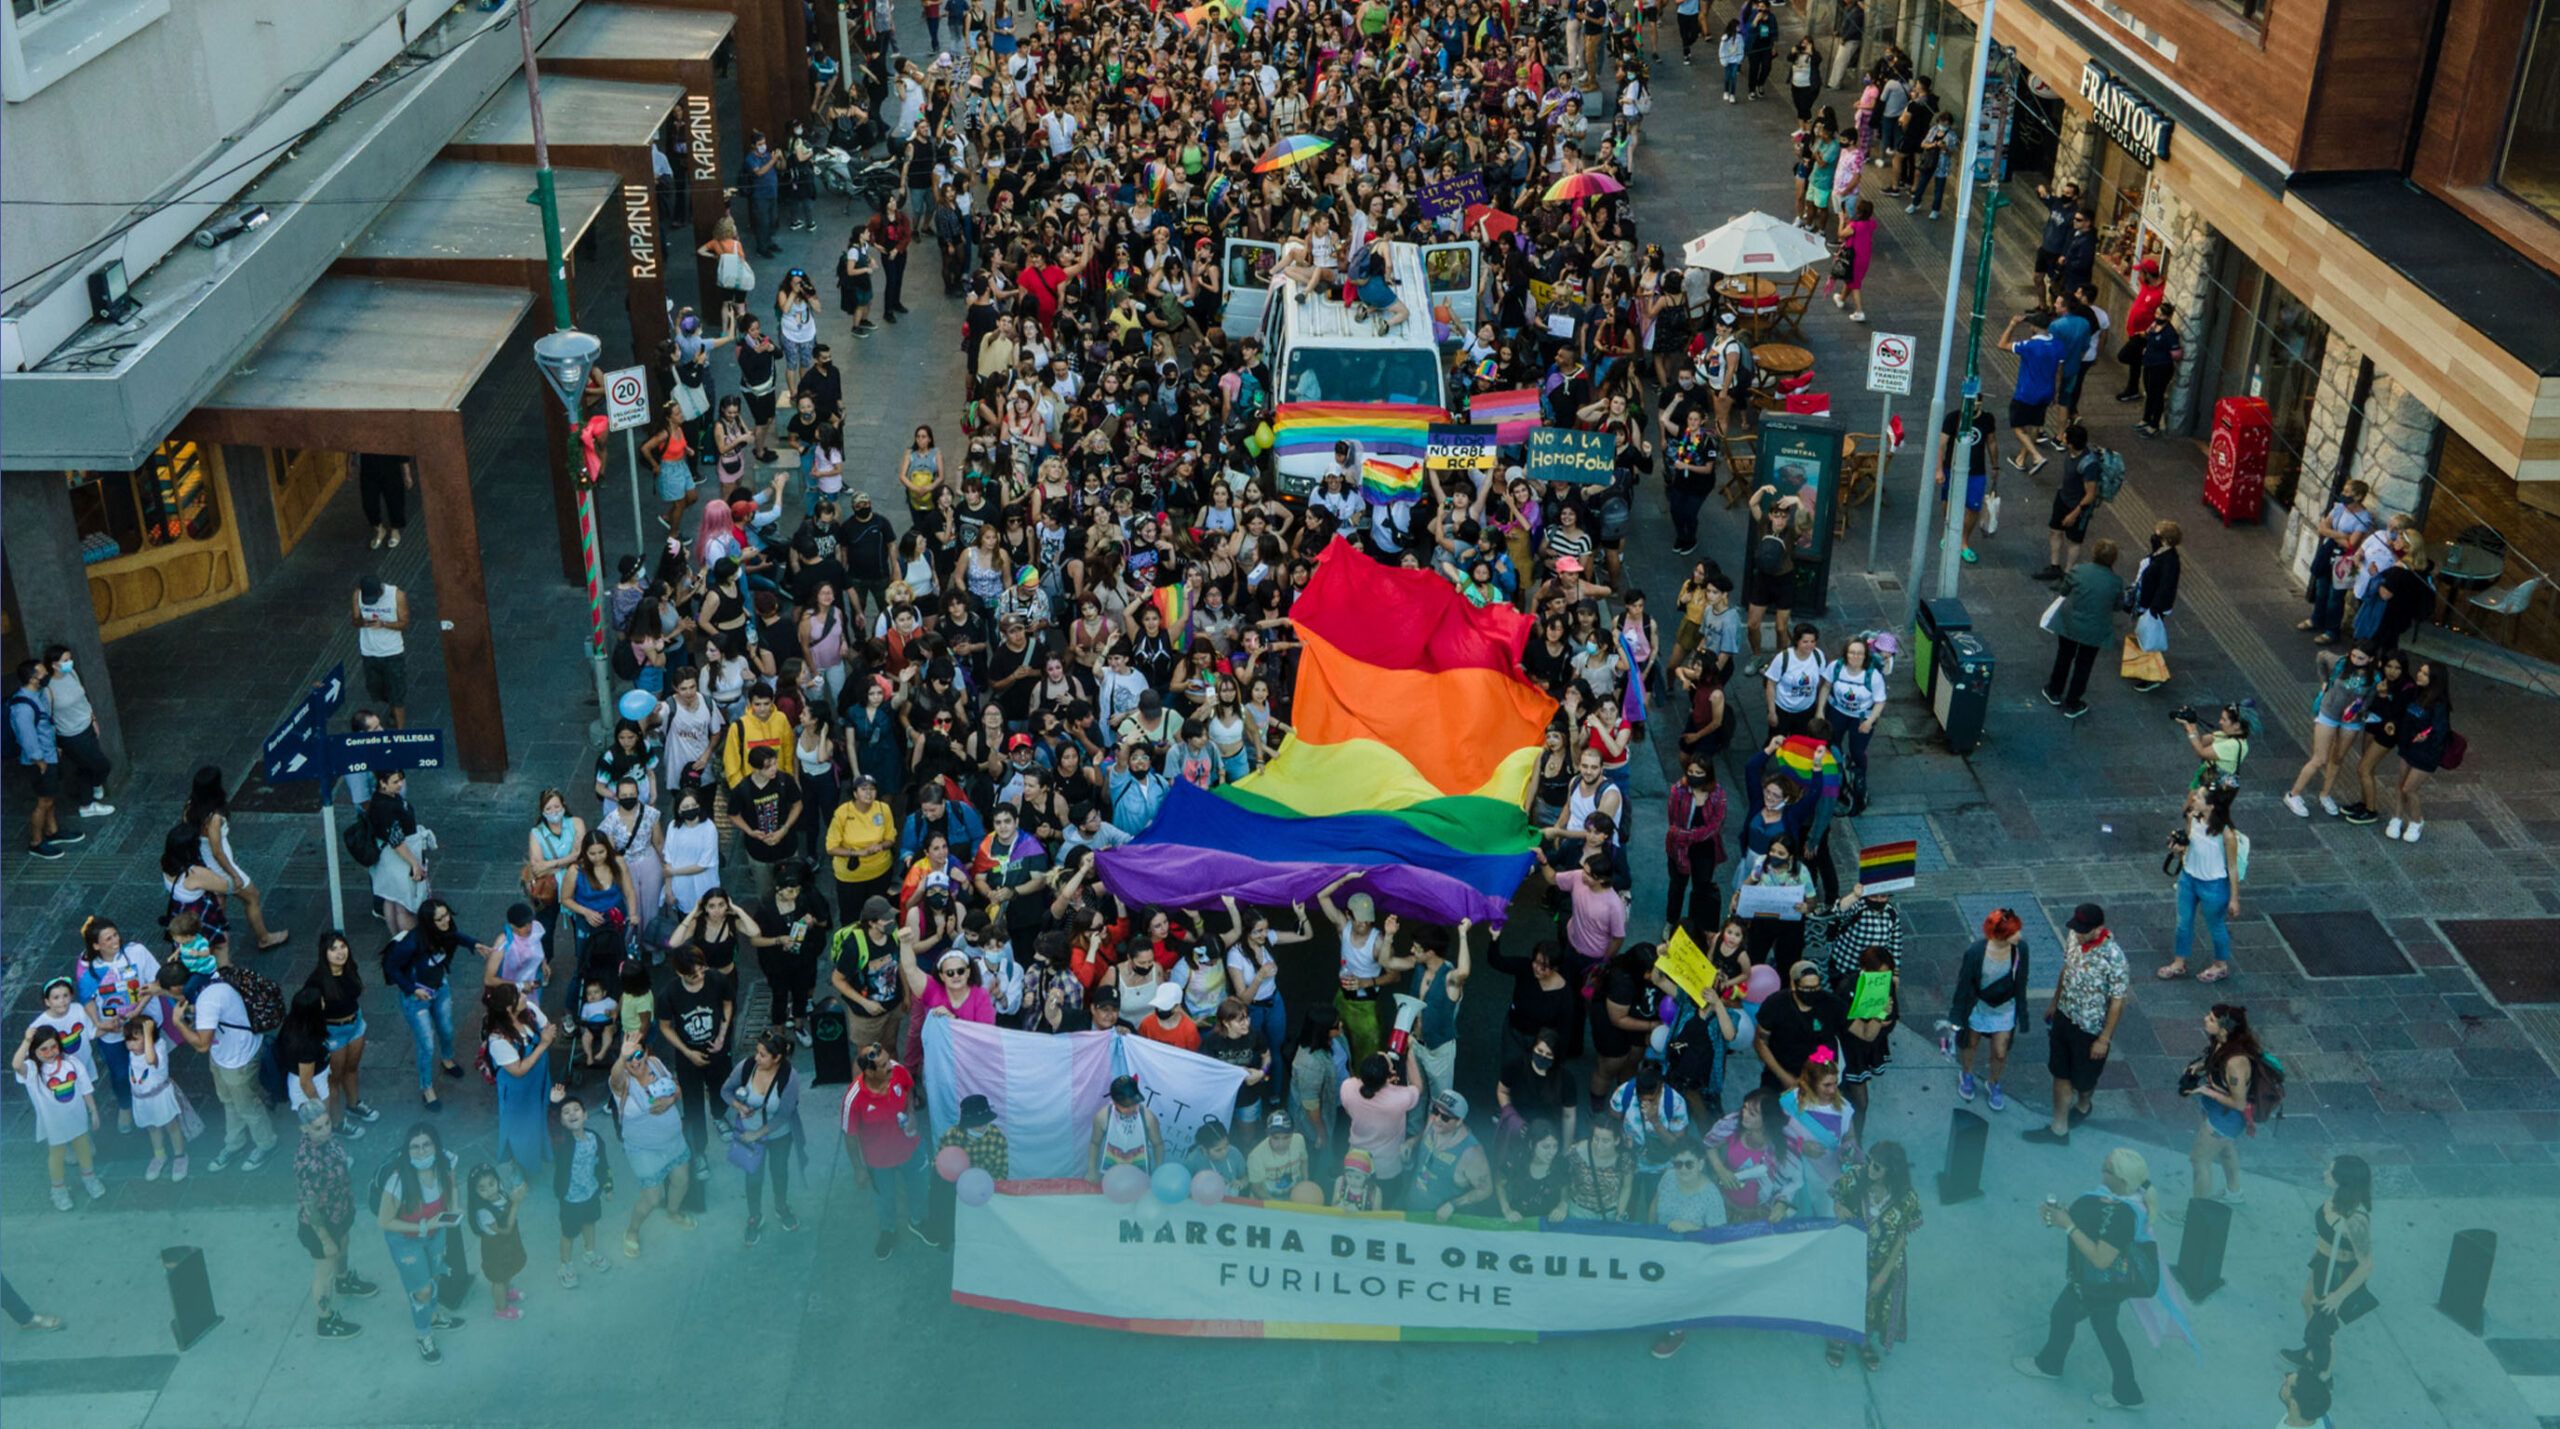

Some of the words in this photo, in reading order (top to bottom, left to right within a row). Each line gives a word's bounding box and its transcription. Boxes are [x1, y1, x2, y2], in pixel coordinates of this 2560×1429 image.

[2080, 64, 2164, 156] FRANTOM
[687, 95, 716, 181] RAPANUI
[2093, 109, 2152, 166] CHOCOLATES
[623, 184, 658, 279] RAPANUI
[617, 382, 636, 399] 20
[1430, 446, 1448, 457] NO
[1452, 445, 1486, 457] CABE
[1534, 431, 1554, 446] NO
[1562, 433, 1573, 445] A
[1581, 434, 1602, 449] LA
[345, 735, 382, 747] Conrado
[393, 733, 436, 745] VILLEGAS
[348, 763, 368, 773] 100
[418, 757, 438, 768] 200
[1118, 1219, 1305, 1253] MARCHA
[1330, 1233, 1416, 1266] DEL
[1441, 1246, 1666, 1283] ORGULLO
[1220, 1262, 1513, 1306] FURILOFCHE
